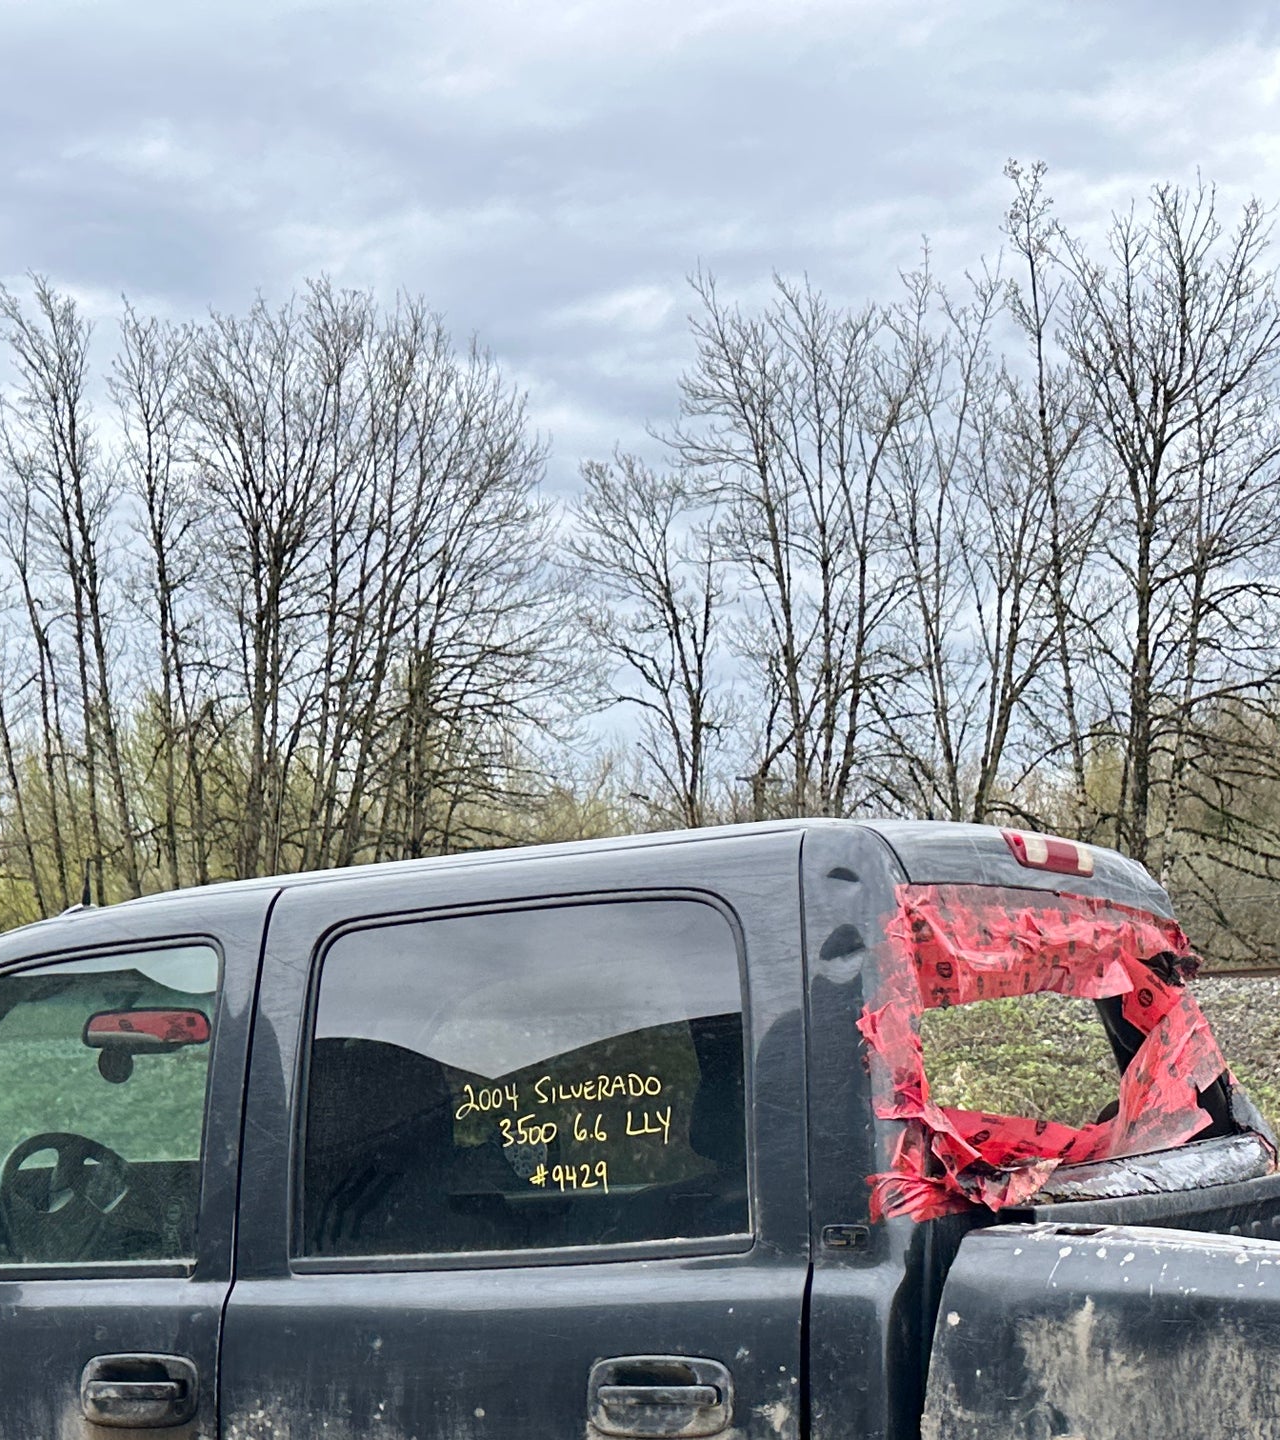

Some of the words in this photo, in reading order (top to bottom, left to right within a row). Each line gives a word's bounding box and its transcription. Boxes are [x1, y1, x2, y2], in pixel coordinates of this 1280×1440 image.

[455, 1083, 519, 1120] 2004
[535, 1073, 662, 1104] SILVERADO
[499, 1114, 558, 1148] 3500
[573, 1112, 608, 1142] 6.6
[626, 1106, 672, 1145] LLY
[529, 1160, 610, 1194] #9429
[826, 1228, 864, 1246] LT
